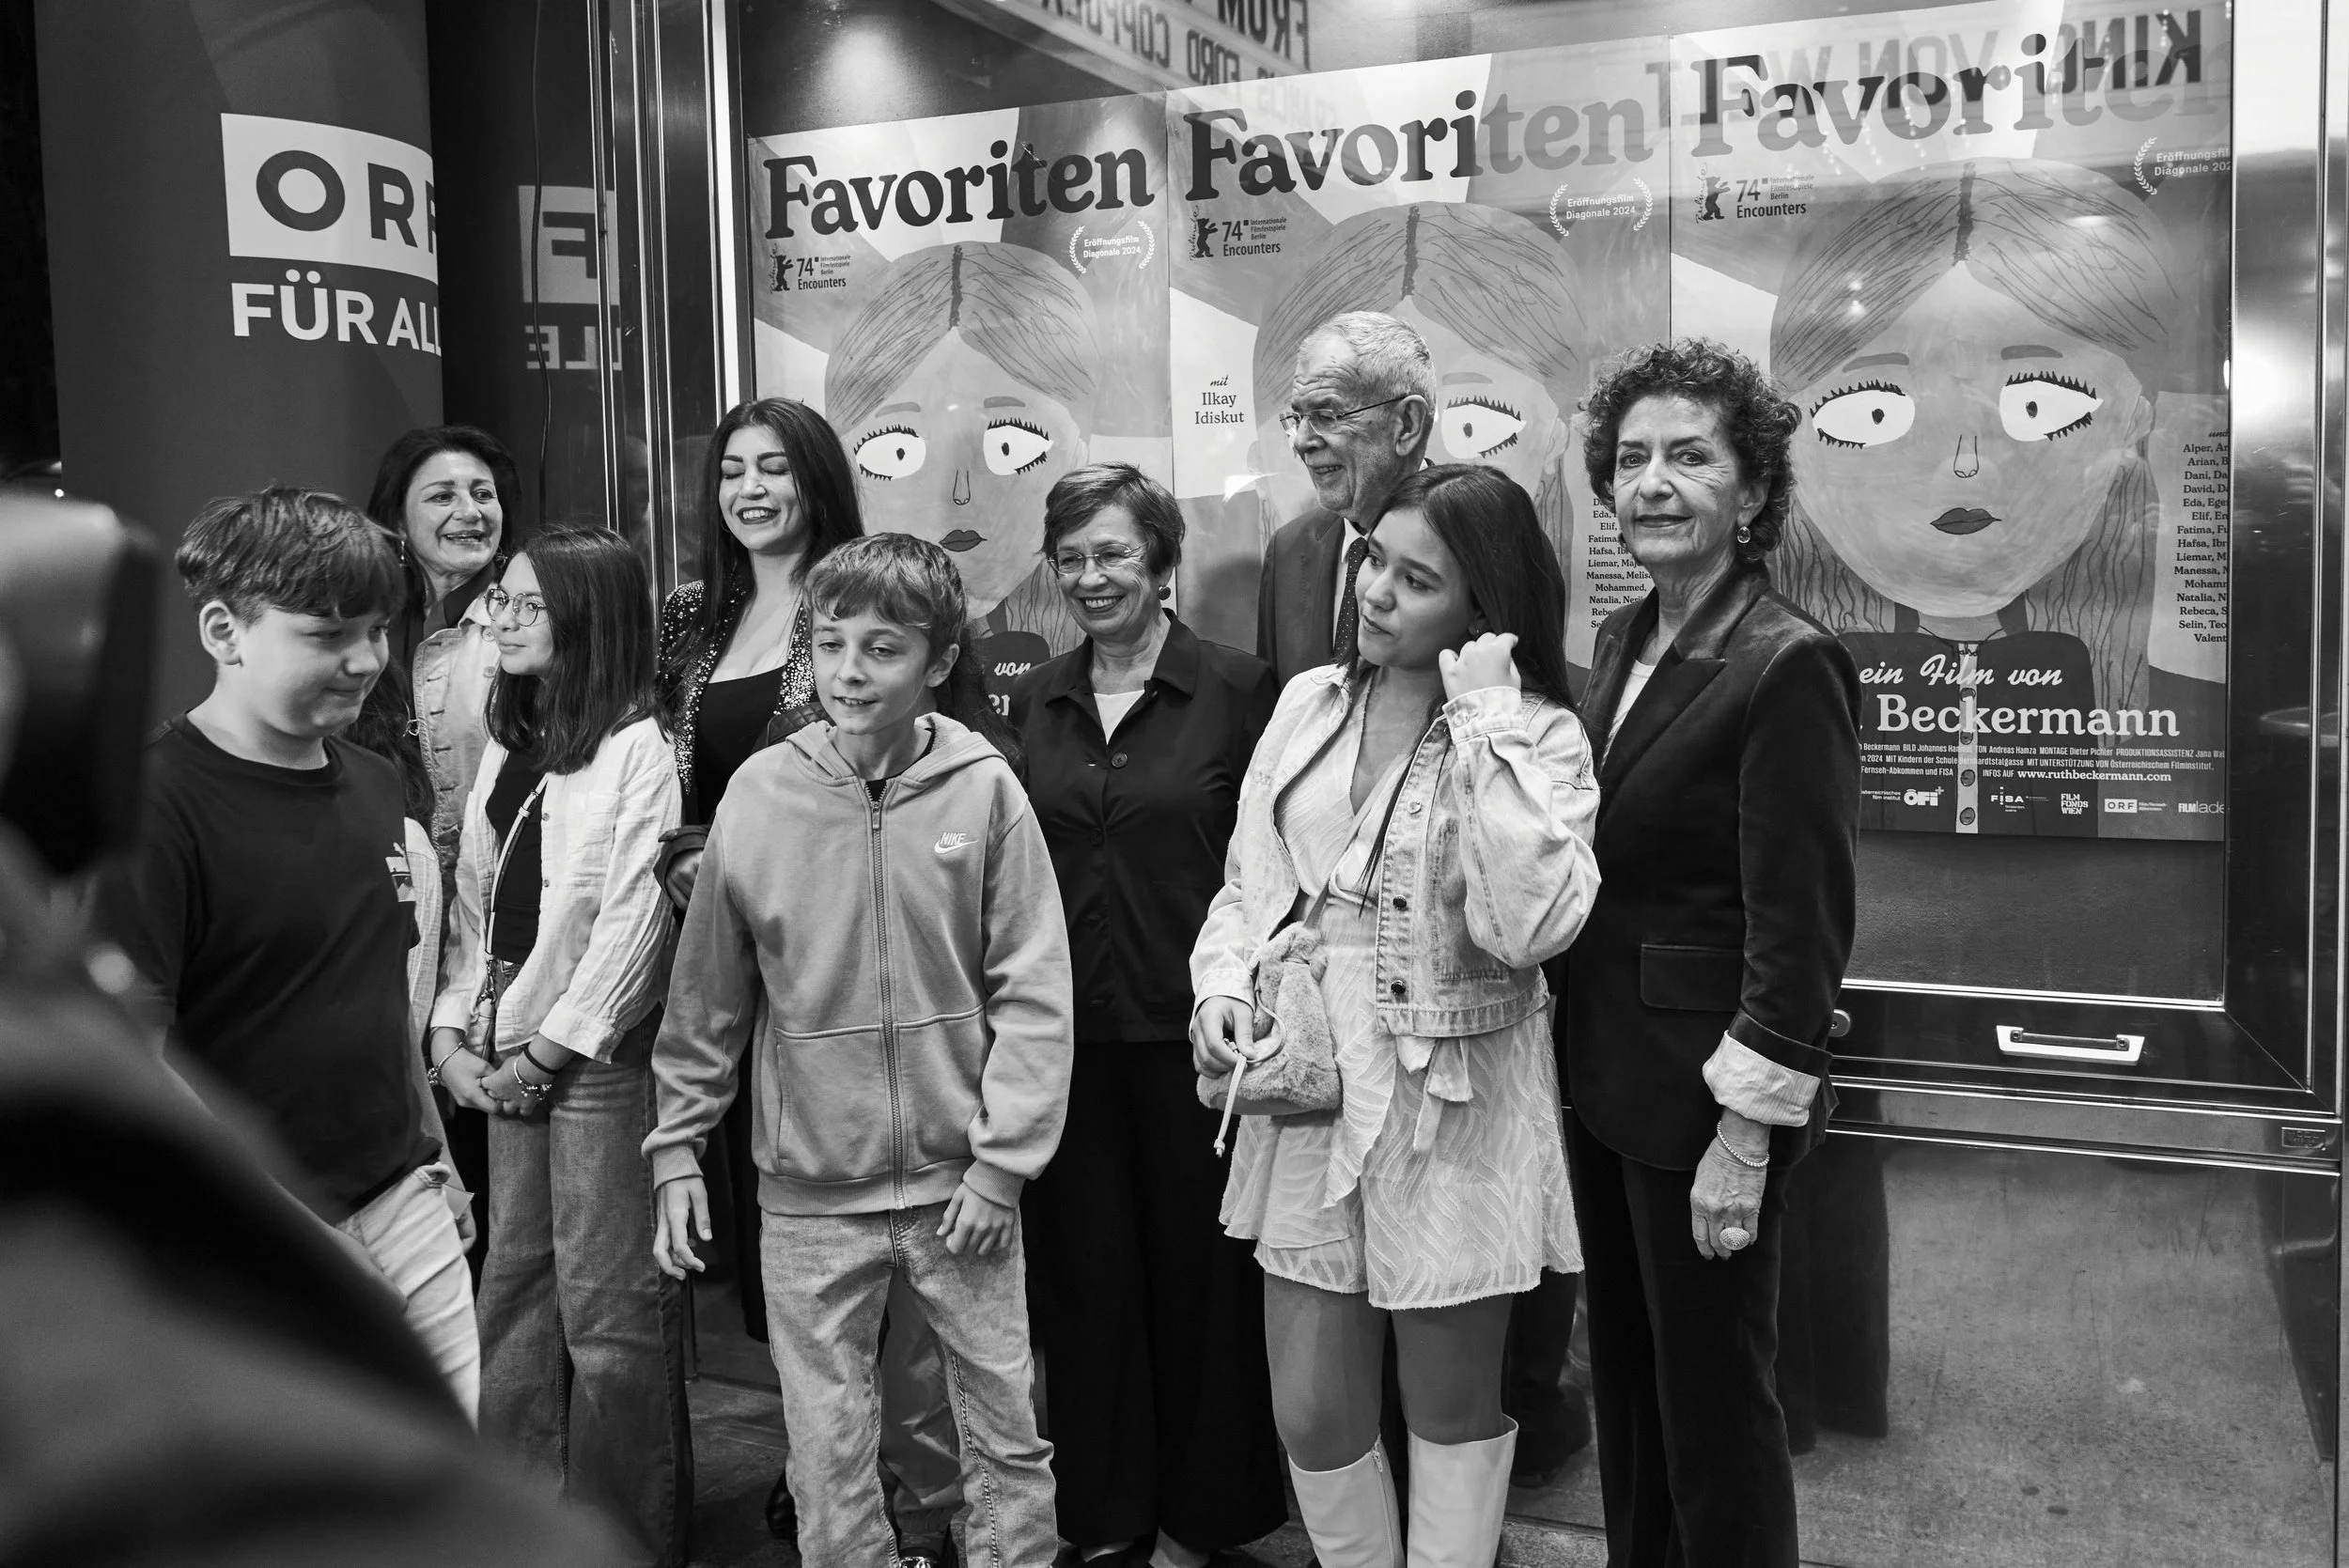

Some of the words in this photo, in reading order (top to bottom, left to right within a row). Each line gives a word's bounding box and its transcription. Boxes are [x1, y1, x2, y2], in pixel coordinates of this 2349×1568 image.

[1183, 90, 1655, 201] Favoriten
[2156, 148, 2230, 163] Eröffnungsfil
[2155, 163, 2209, 177] Diagonale
[763, 140, 1155, 240] Favoriten
[1567, 194, 1634, 207] Eröffnungsfilm
[1770, 192, 1789, 200] Berlin
[1565, 208, 1610, 221] Diagonale
[1613, 206, 1636, 216] 2024
[1736, 203, 1807, 219] Encounters
[1251, 216, 1287, 225] Internationale
[1251, 225, 1286, 233] Filmfestspiele
[1083, 235, 1140, 247] Eröffnungsfilm
[1082, 248, 1121, 259] Diagonale
[1122, 246, 1141, 256] 2024
[1223, 242, 1281, 256] Encounters
[798, 277, 847, 290] Encounters
[231, 269, 379, 345] FÜR
[386, 297, 442, 357] ALL
[1210, 374, 1229, 386] mit
[1202, 392, 1237, 408] Ilkay
[1194, 411, 1245, 424] Idiskut
[2183, 443, 2214, 454] Alper,
[2187, 458, 2219, 466] Arian,
[2185, 471, 2211, 480] Dani,
[2184, 485, 2216, 493] David,
[2183, 498, 2205, 507] Eda,
[2207, 497, 2229, 508] Ege
[1593, 510, 1611, 519] Eda,
[2191, 511, 2212, 520] Elif,
[1600, 522, 1617, 531] Elif,
[2177, 525, 2215, 535] Fatima,
[2177, 538, 2210, 548] Hafsa,
[1589, 547, 1616, 555] Hafsa,
[2176, 552, 2215, 562] Liemar,
[1588, 559, 1620, 568] Liemar,
[1586, 571, 1625, 580] Manessa,
[2174, 566, 2220, 575] Manessa,
[1595, 583, 1647, 592] Mohammed,
[1589, 596, 1621, 604] Natalia,
[2176, 593, 2216, 602] Natalia,
[2180, 606, 2219, 615] Rebeca,
[2178, 620, 2207, 629] Selin,
[1859, 661, 1904, 684] ein
[1920, 653, 1994, 686] Film
[2008, 668, 2063, 686] von
[1876, 694, 2181, 737] Beckermann
[1863, 743, 1901, 752] Beckermann
[1918, 744, 1948, 753] Johannes
[1989, 745, 2015, 754] Andreas
[2015, 746, 2037, 754] Hamza
[2040, 747, 2068, 755] MONTAGE
[2069, 747, 2089, 755] Dieter
[2091, 748, 2113, 756] Pichler
[2116, 748, 2194, 758] PRODUKTIONSASSISTENZ
[2195, 750, 2212, 758] Jana
[1898, 755, 1922, 764] Kindern
[1936, 755, 1958, 765] Schule
[2027, 758, 2039, 767] MIT
[2040, 758, 2094, 768] UNTERSTÜTZUNG
[2095, 759, 2109, 768] VON
[2110, 759, 2170, 769] Österreichischem
[2171, 761, 2215, 770] Filminstitut,
[1860, 766, 1924, 775] Fernseh-Abkommen
[1925, 768, 1938, 776] und
[1983, 768, 2001, 778] INFOS
[2002, 768, 2015, 778] AUF
[2017, 769, 2172, 782] www.ruthbeckermann.com
[2108, 801, 2135, 810] ORF
[941, 832, 967, 846] NIKE
